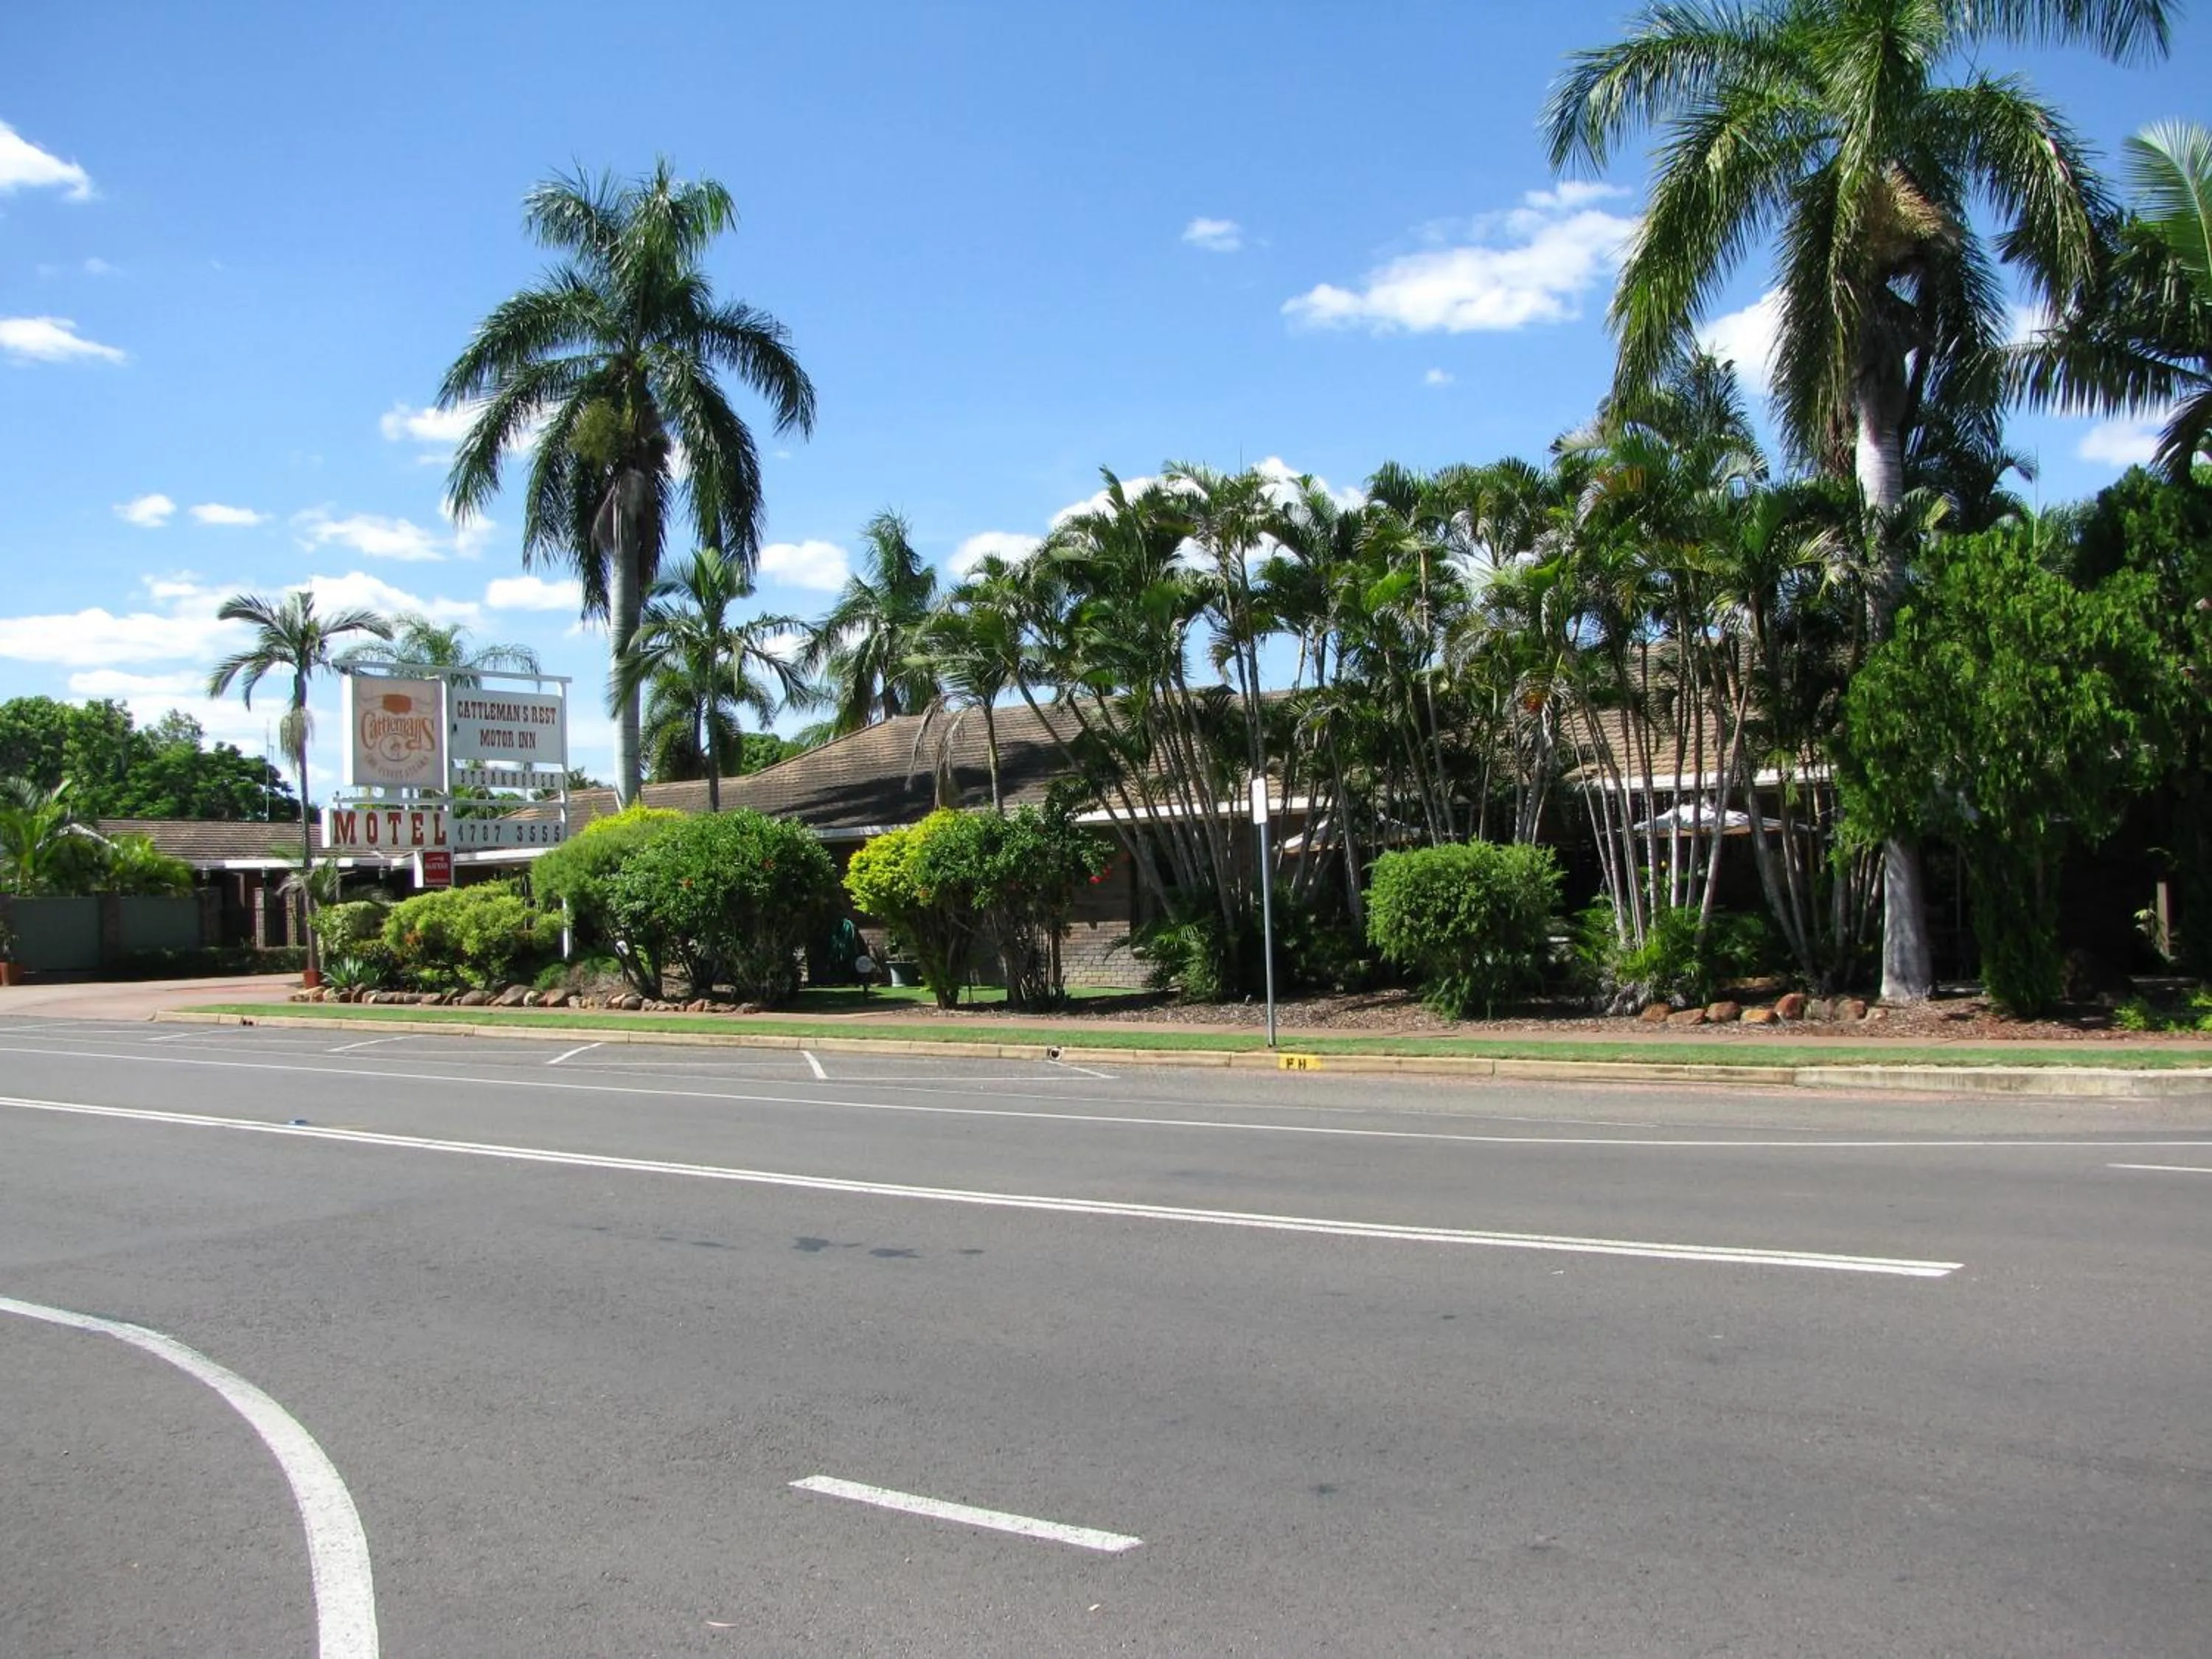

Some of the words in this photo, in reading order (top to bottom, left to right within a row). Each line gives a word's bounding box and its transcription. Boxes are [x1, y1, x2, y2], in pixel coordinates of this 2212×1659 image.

[457, 700, 529, 723] CATTLEMANS
[532, 706, 557, 725] REST
[480, 728, 514, 748] MOTOR
[518, 730, 537, 749] INN
[461, 769, 556, 787] STEAKHOUSE
[333, 810, 447, 845] MOTEL
[517, 824, 560, 842] 3555
